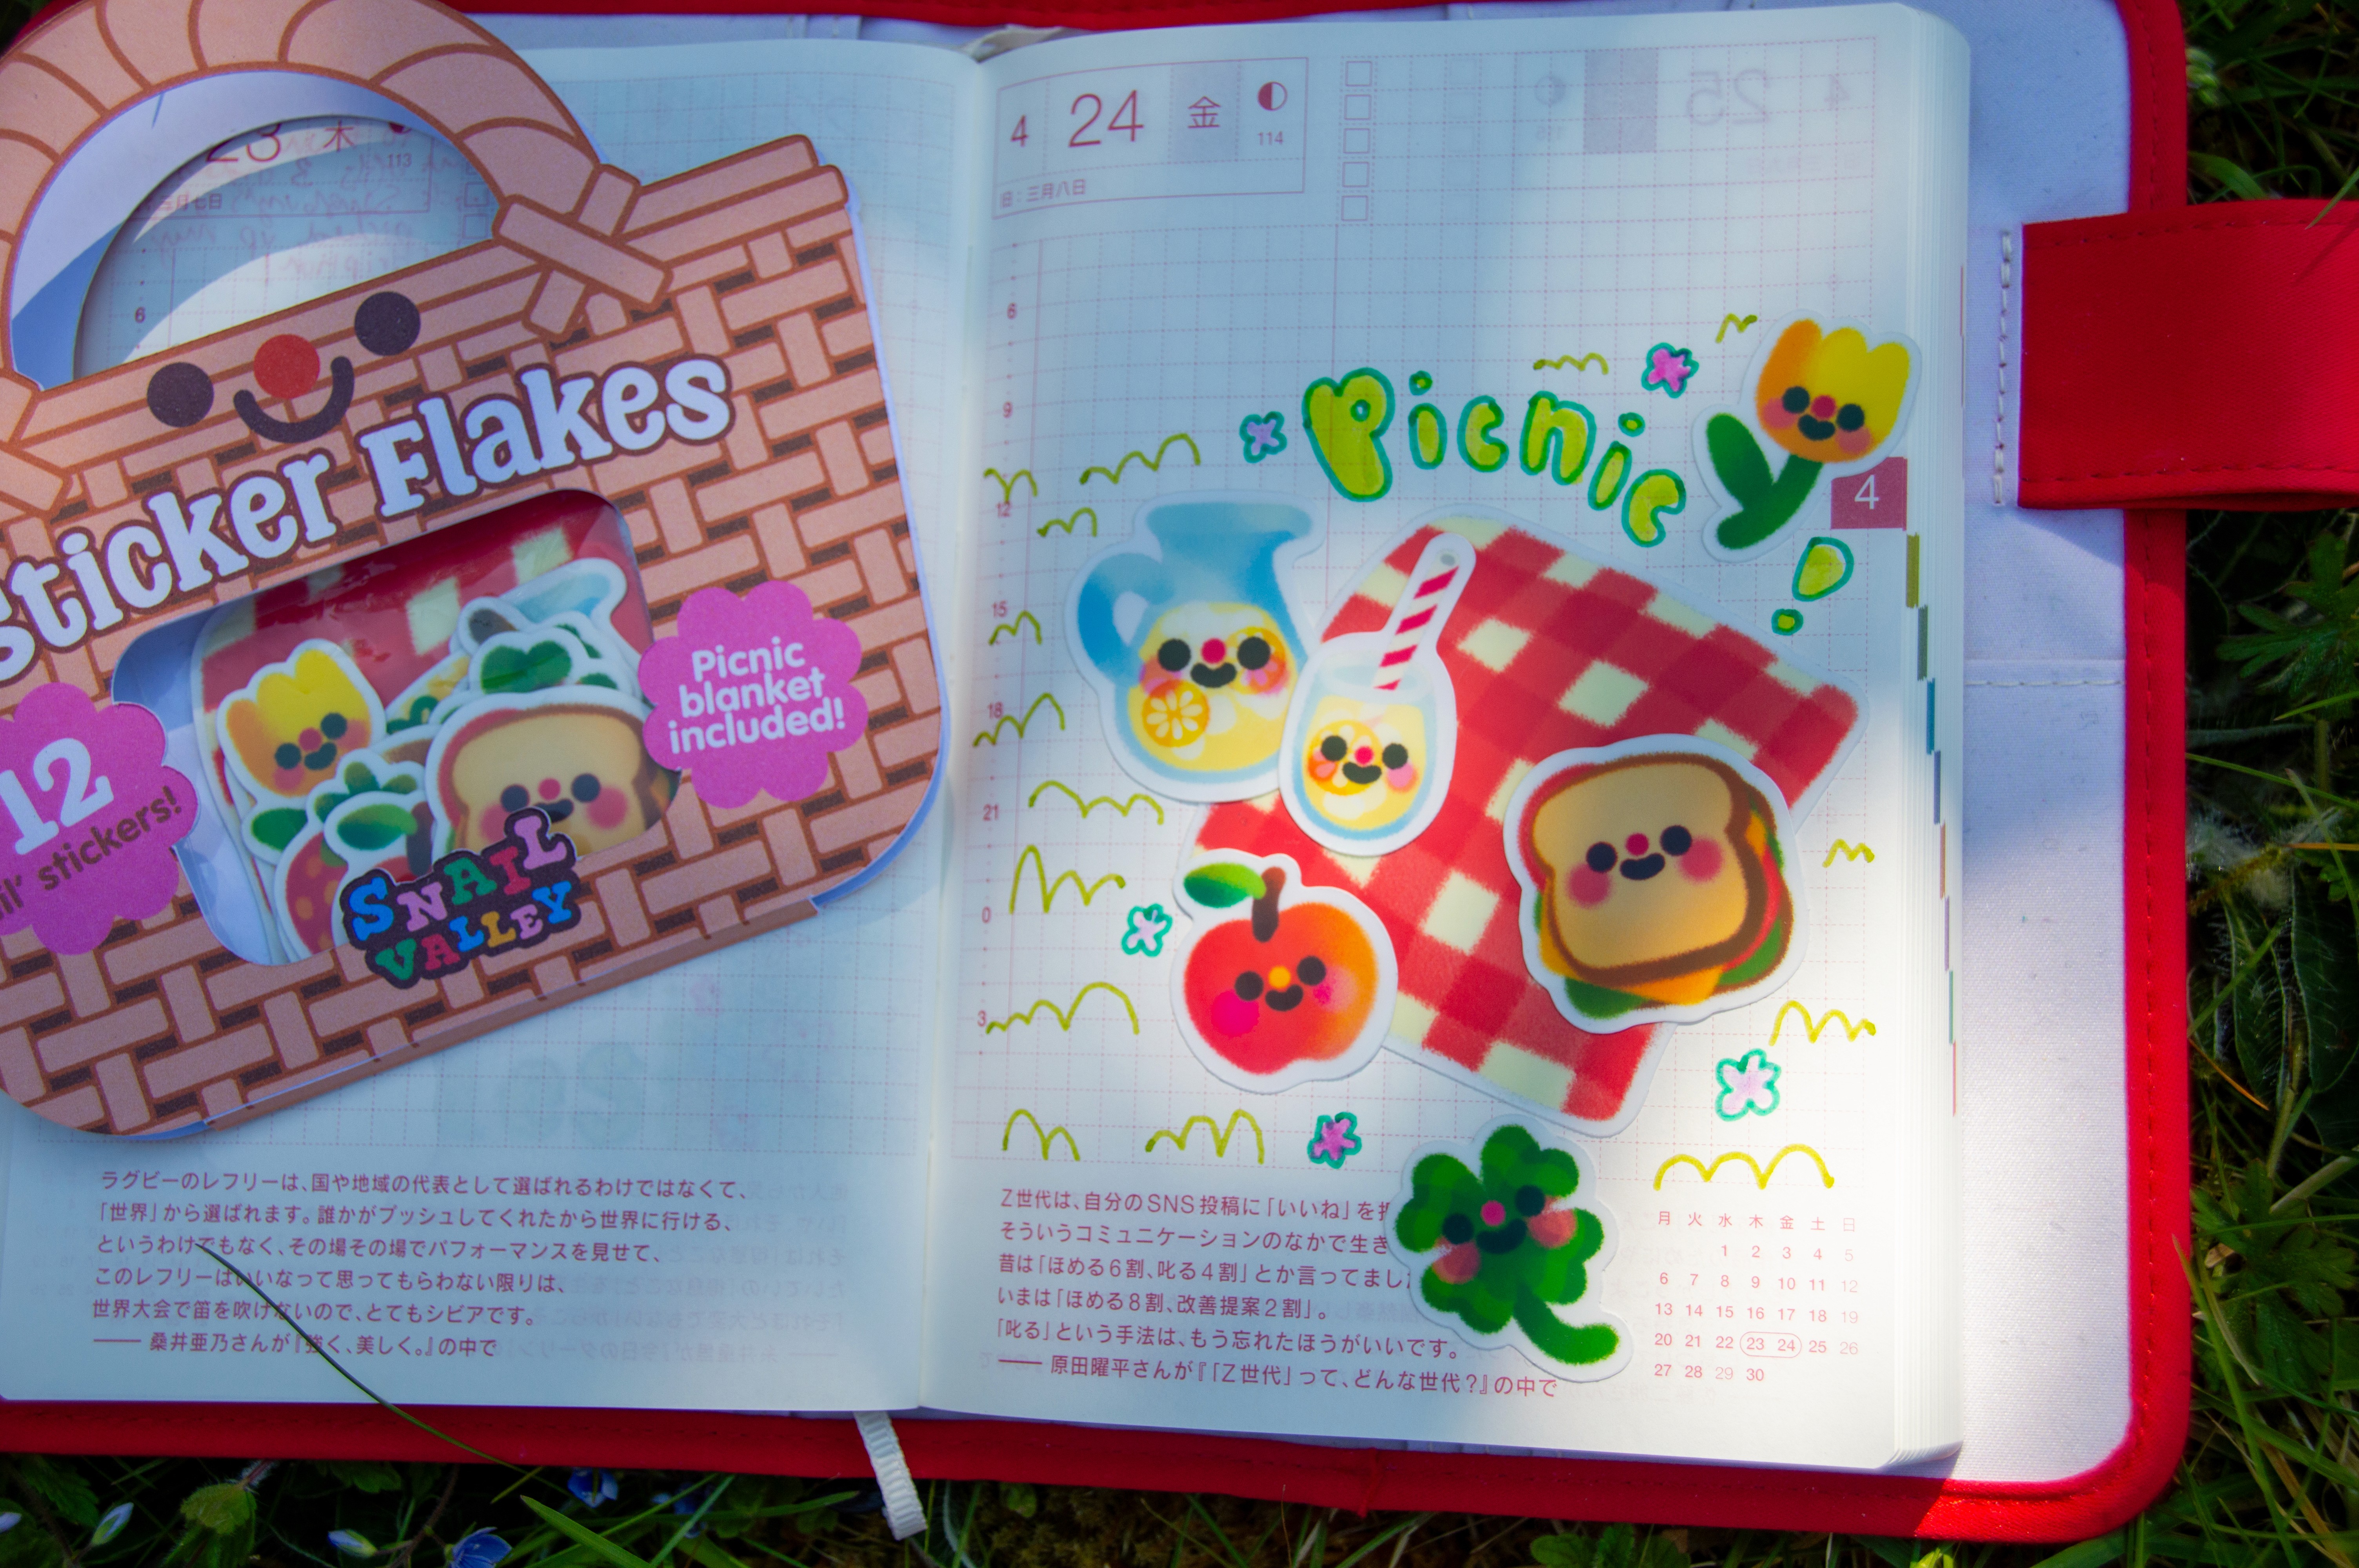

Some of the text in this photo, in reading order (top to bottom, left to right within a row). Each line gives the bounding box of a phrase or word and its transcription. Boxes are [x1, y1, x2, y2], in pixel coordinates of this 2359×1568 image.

[1011, 90, 1221, 148] 4 24 金
[325, 120, 354, 152] 木
[1258, 131, 1283, 145] 114
[388, 152, 412, 168] 113
[135, 307, 146, 323] 6
[1007, 303, 1016, 319] 6
[1003, 402, 1012, 418] 9
[358, 358, 731, 518] Flakes
[1302, 367, 1687, 547] Picnic
[1854, 474, 1879, 510] 4
[996, 501, 1010, 517] 12
[993, 601, 1007, 617] 15
[691, 636, 806, 682] Picnic
[678, 666, 825, 718] blanket
[989, 702, 1003, 719] 18
[668, 697, 846, 755] included!
[0, 737, 114, 855] 12
[983, 805, 999, 821] 21
[0, 785, 182, 920] il' stickers!
[348, 814, 568, 942] SNAIL
[982, 907, 991, 923] 0
[374, 880, 573, 981] VALLEY
[978, 1011, 986, 1027] 3
[102, 1171, 746, 1200] ラグビーのレフリーは、国や地域の代表として選ばれるわけではなくて、
[1658, 1210, 1855, 1232] 月 火 水 木 金 土 日
[1000, 1221, 1387, 1254] そういうコミュニケーションのなかで生き
[1721, 1245, 1854, 1262] 1 2 3 4 5
[998, 1253, 1410, 1289] 昔は「ほめる6割、叱る4割」とか言ってまし
[1659, 1272, 1858, 1293] 6 7 8 9 10 11 12
[1655, 1303, 1859, 1324] 13 14 15 16 17 18 19
[1654, 1332, 1859, 1355] 20 21 22 23 24 25 26
[1654, 1363, 1765, 1381] 27 28 29 30
